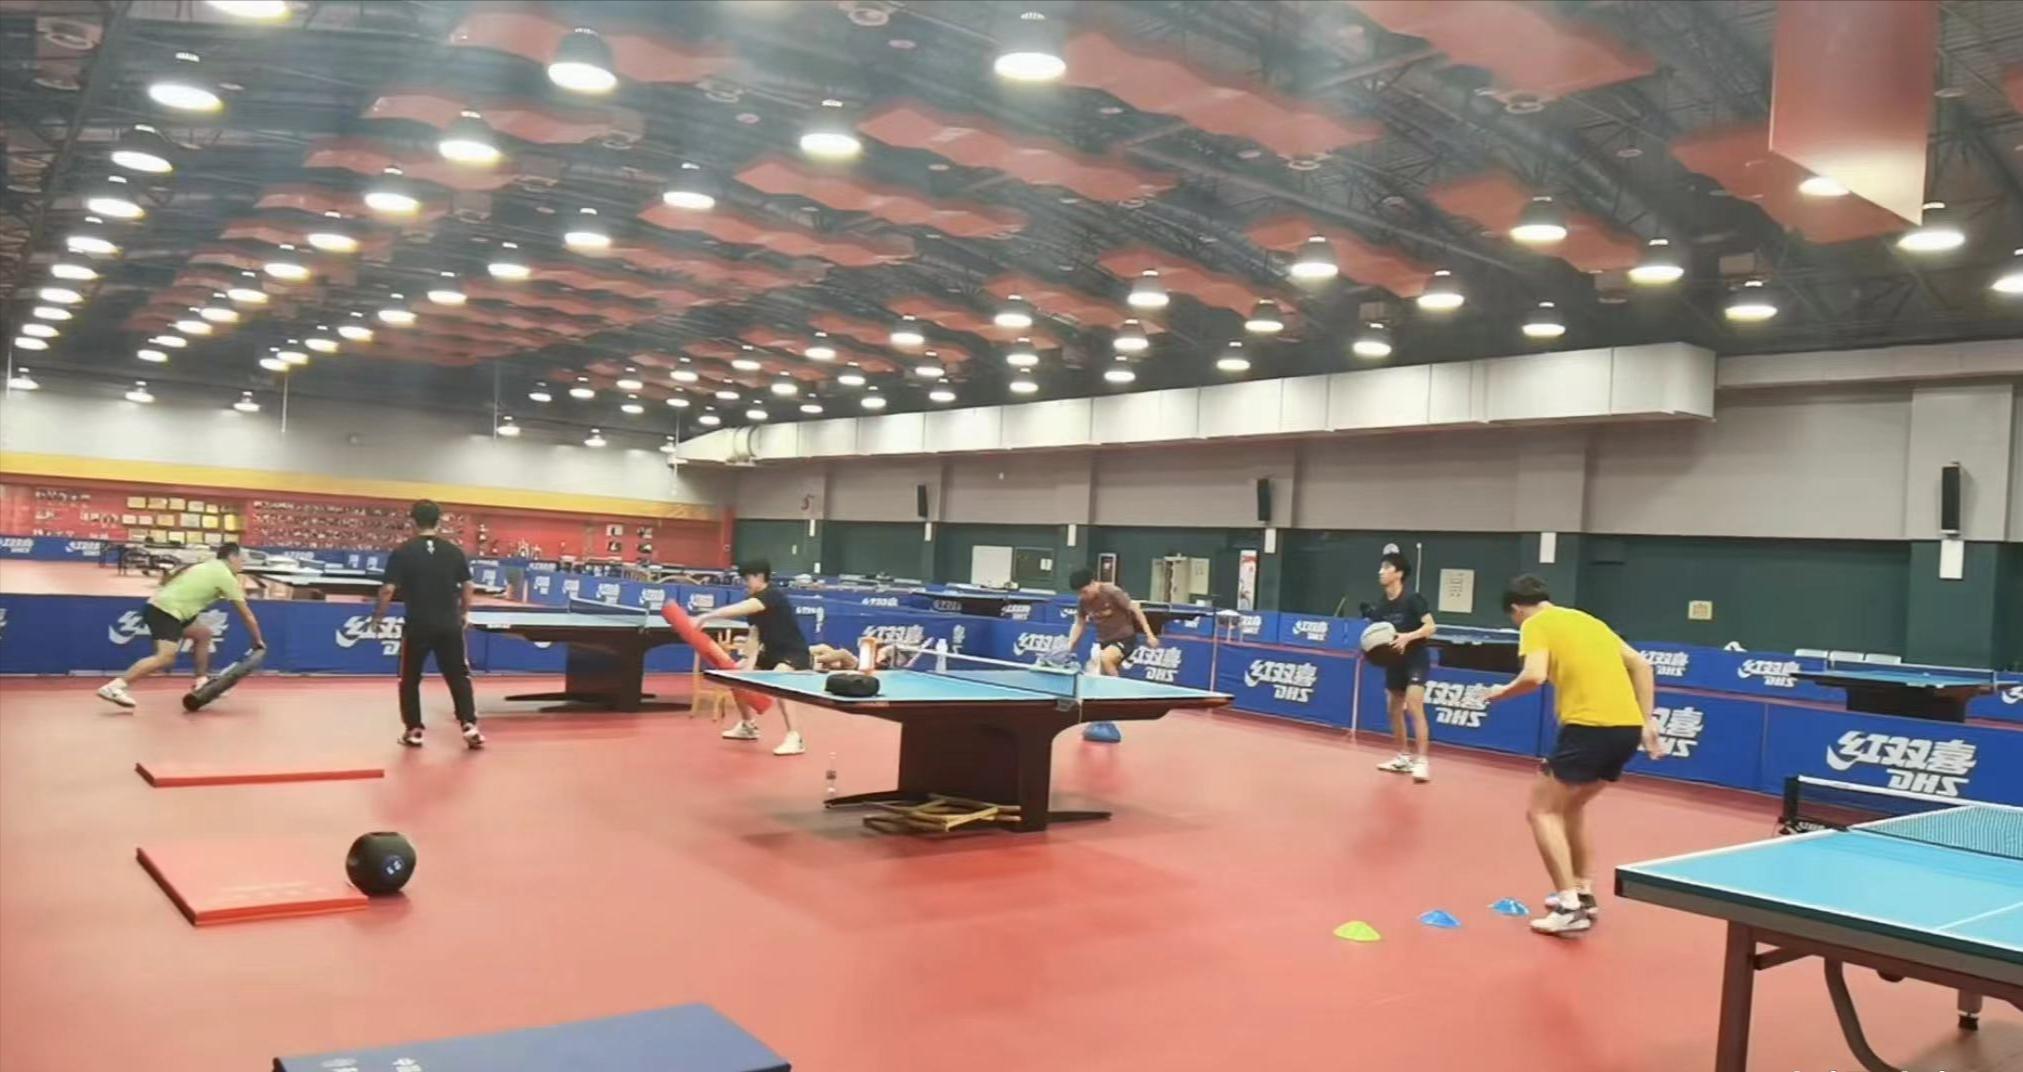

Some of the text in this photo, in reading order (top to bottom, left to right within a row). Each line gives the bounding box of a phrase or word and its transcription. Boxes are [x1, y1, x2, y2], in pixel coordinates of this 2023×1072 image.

[1244, 659, 1318, 687] 红双喜
[1272, 684, 1315, 703] DHS
[1434, 707, 1488, 728] DHS
[1826, 730, 1978, 775] 红双喜
[1885, 768, 1970, 797] DHS
